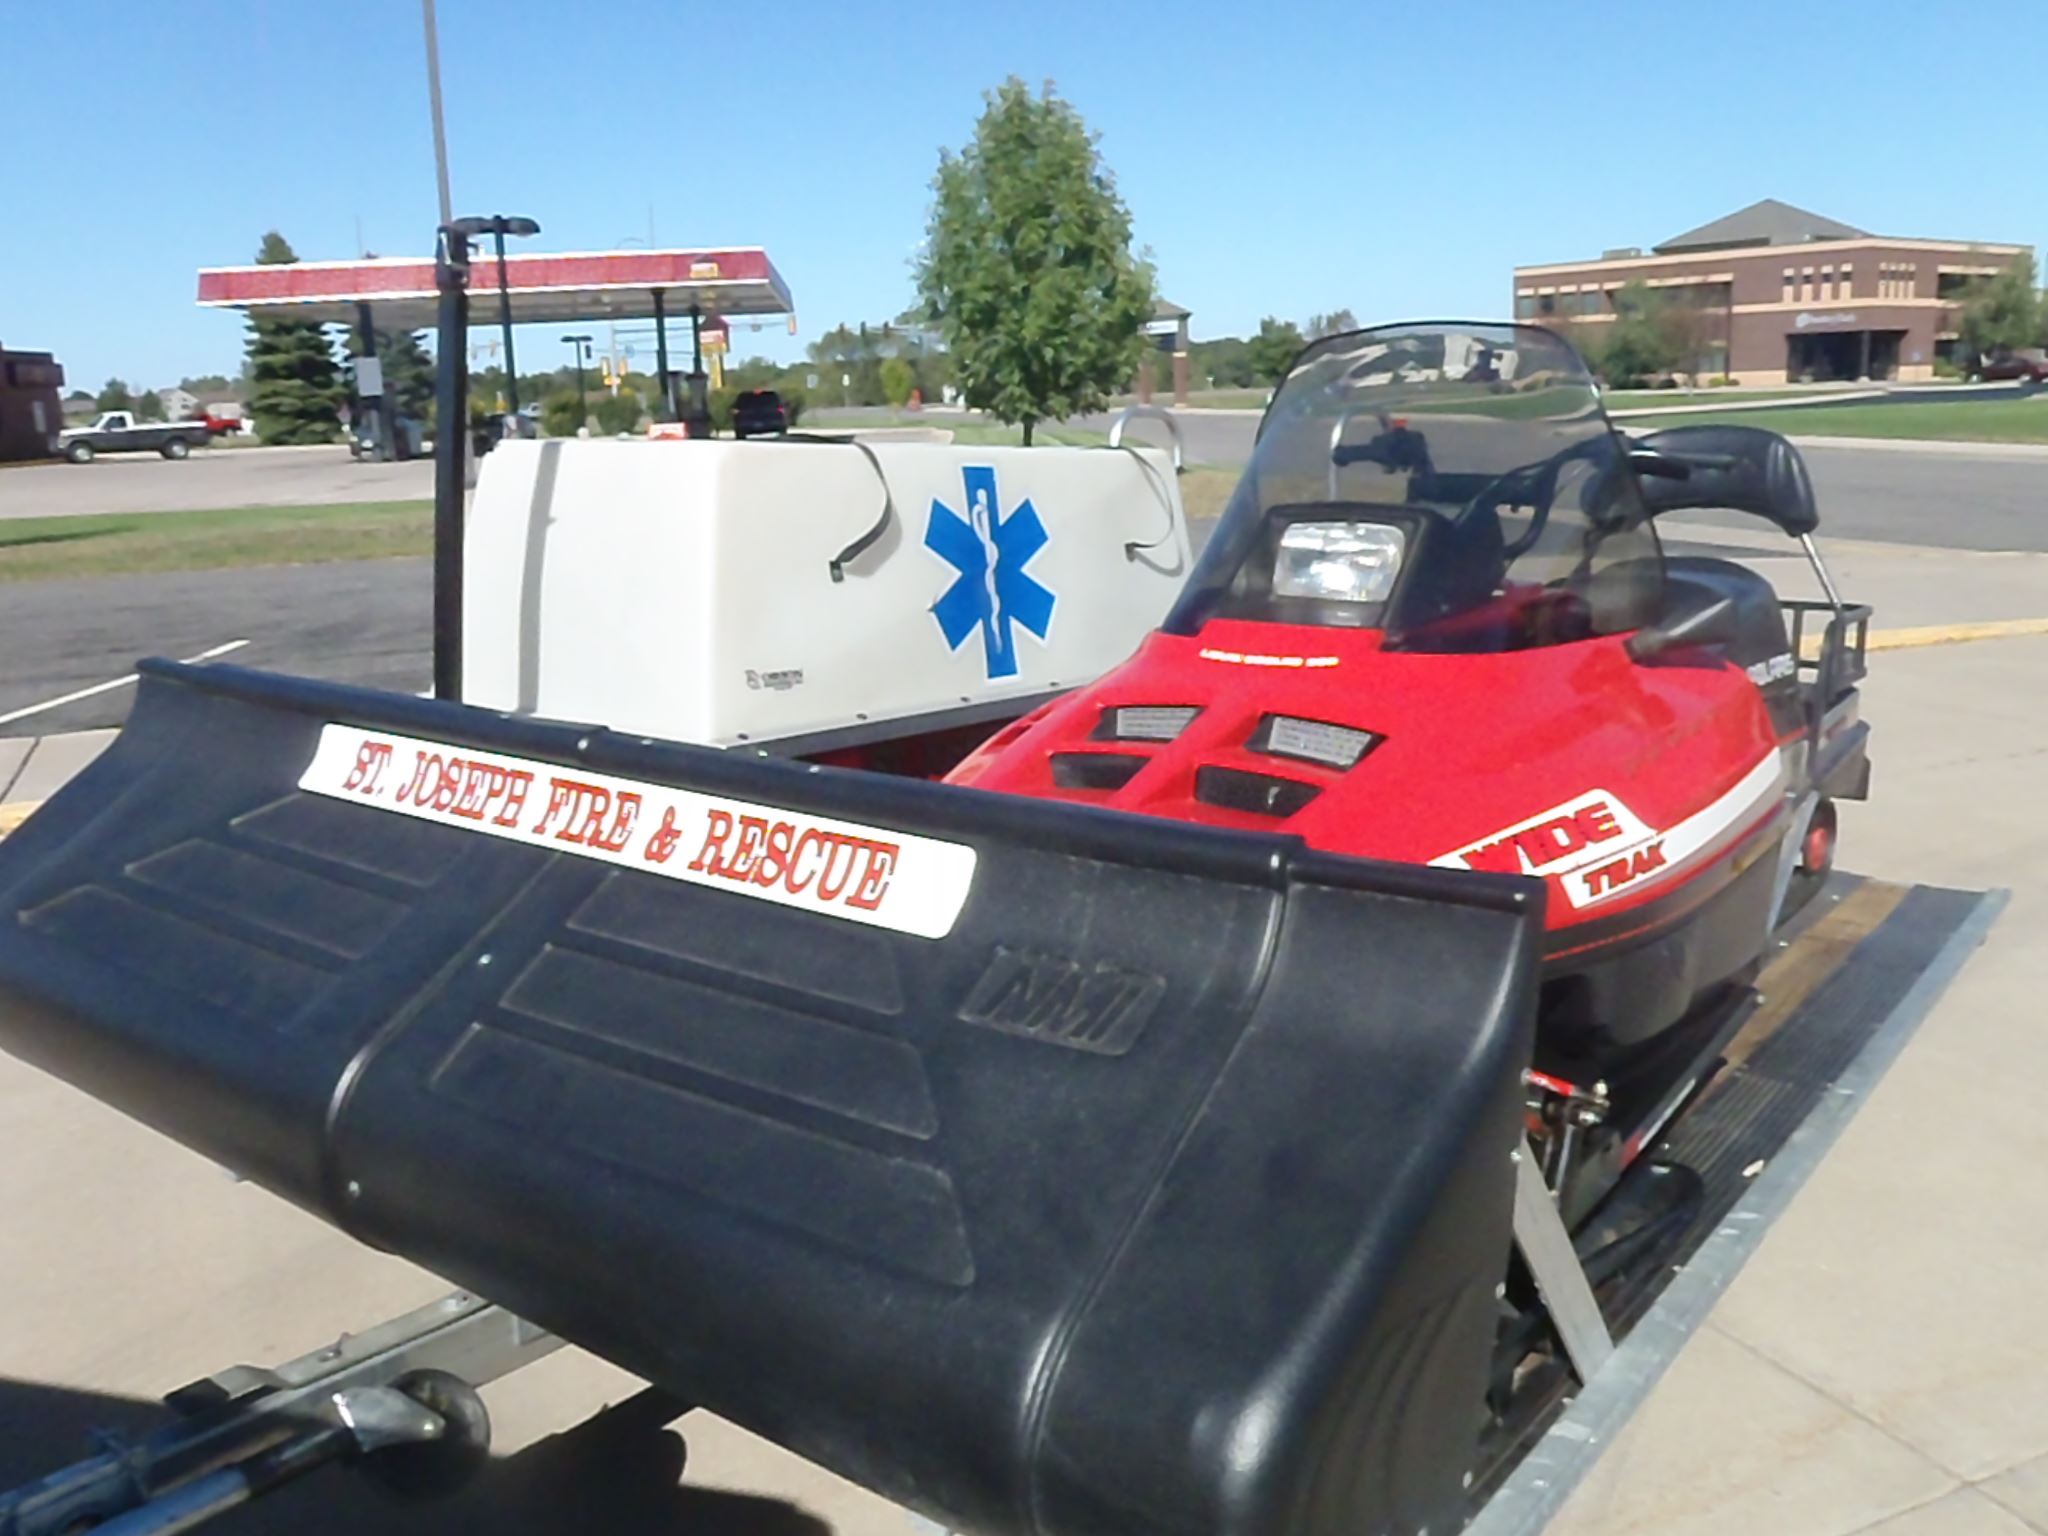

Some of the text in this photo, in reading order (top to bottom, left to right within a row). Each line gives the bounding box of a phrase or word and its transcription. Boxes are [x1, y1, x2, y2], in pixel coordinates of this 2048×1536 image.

[342, 740, 900, 912] ST. JOSEPH FIRE & RESCUE
[1582, 839, 1668, 897] TRAK
